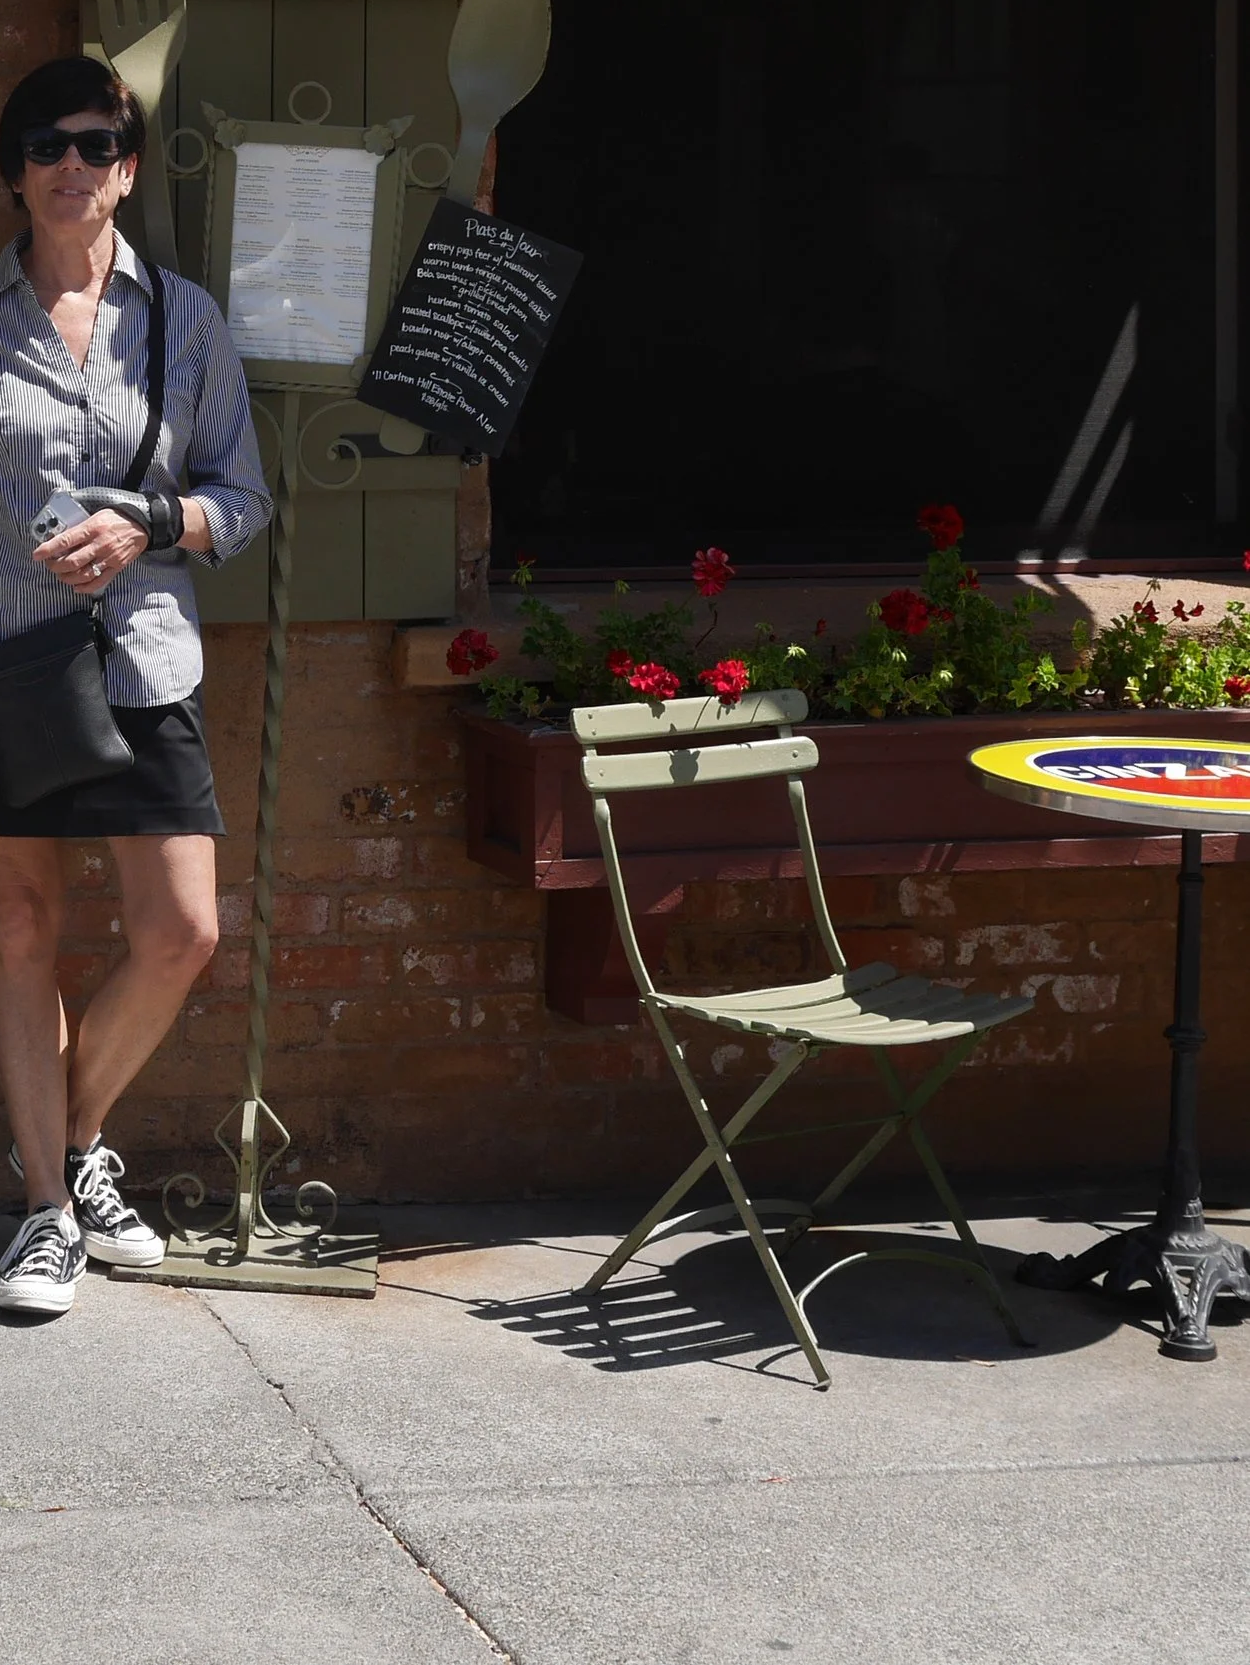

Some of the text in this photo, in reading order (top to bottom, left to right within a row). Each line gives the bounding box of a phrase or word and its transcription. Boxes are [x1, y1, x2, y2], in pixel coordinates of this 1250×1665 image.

[499, 229, 514, 242] du
[423, 256, 450, 267] warm
[451, 260, 474, 273] lamb
[475, 266, 502, 284] tongue
[528, 300, 551, 322] salad
[428, 241, 455, 256] crispy
[456, 246, 473, 258] pigs
[474, 248, 491, 261] feet
[503, 259, 540, 282] mustard
[536, 279, 559, 301] sauce
[477, 284, 508, 303] pickled
[428, 294, 519, 343] heirloom tomato salad
[458, 287, 485, 301] grilled
[486, 297, 510, 316] bread
[401, 322, 432, 336] boudin
[434, 329, 453, 341] noir
[484, 354, 517, 387] potatoes
[402, 305, 432, 319] roasted
[492, 339, 508, 353] pea
[508, 350, 529, 372] coulis
[383, 370, 416, 385] Carlton
[431, 379, 457, 403] Estate
[455, 393, 478, 415] Pinot
[475, 413, 498, 435] Noir
[389, 342, 414, 356] peach
[451, 360, 478, 381] vanilla
[488, 384, 510, 408] cream
[1043, 763, 1250, 780] CINZA
